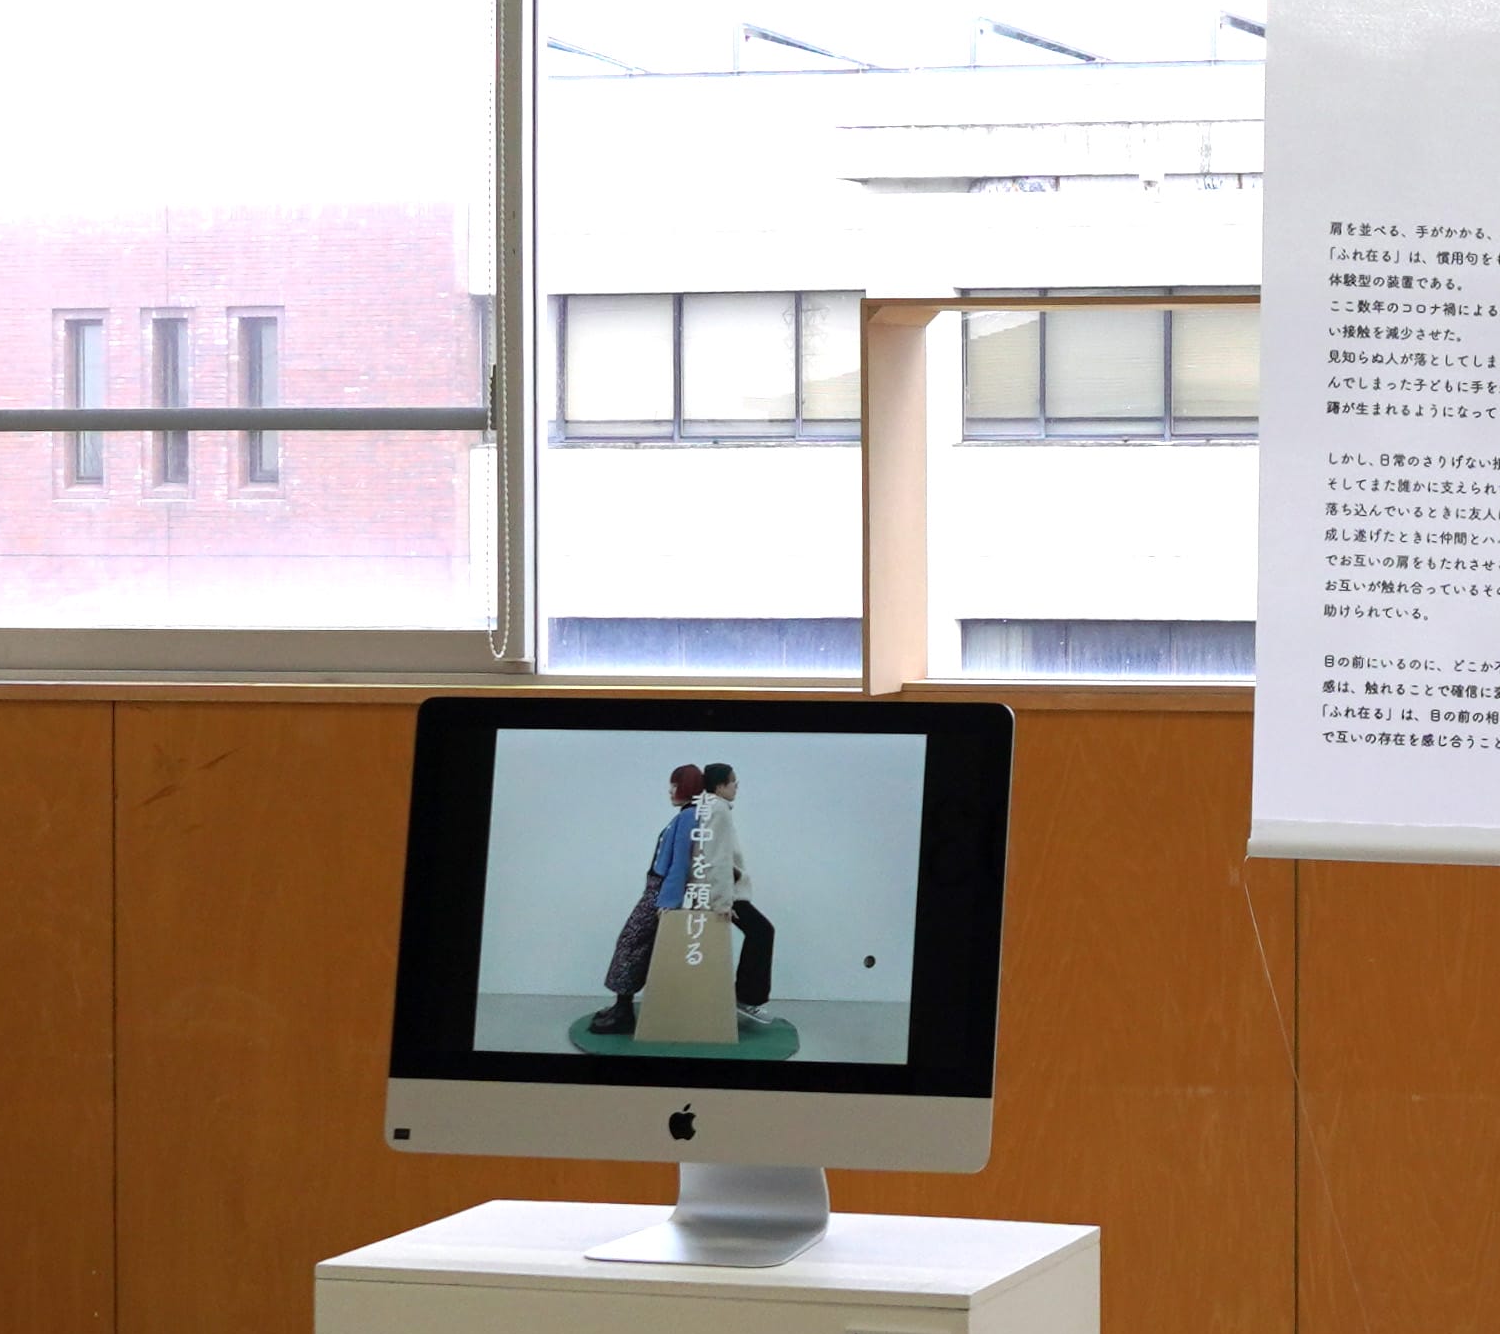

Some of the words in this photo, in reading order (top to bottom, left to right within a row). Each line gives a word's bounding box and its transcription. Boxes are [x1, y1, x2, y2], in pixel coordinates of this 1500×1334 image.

[1329, 273, 1464, 292] 体験型の装置である。
[1328, 324, 1462, 343] い接触を減少させた。
[1323, 604, 1429, 622] 助けられている。
[683, 789, 718, 966] 背中を預ける
